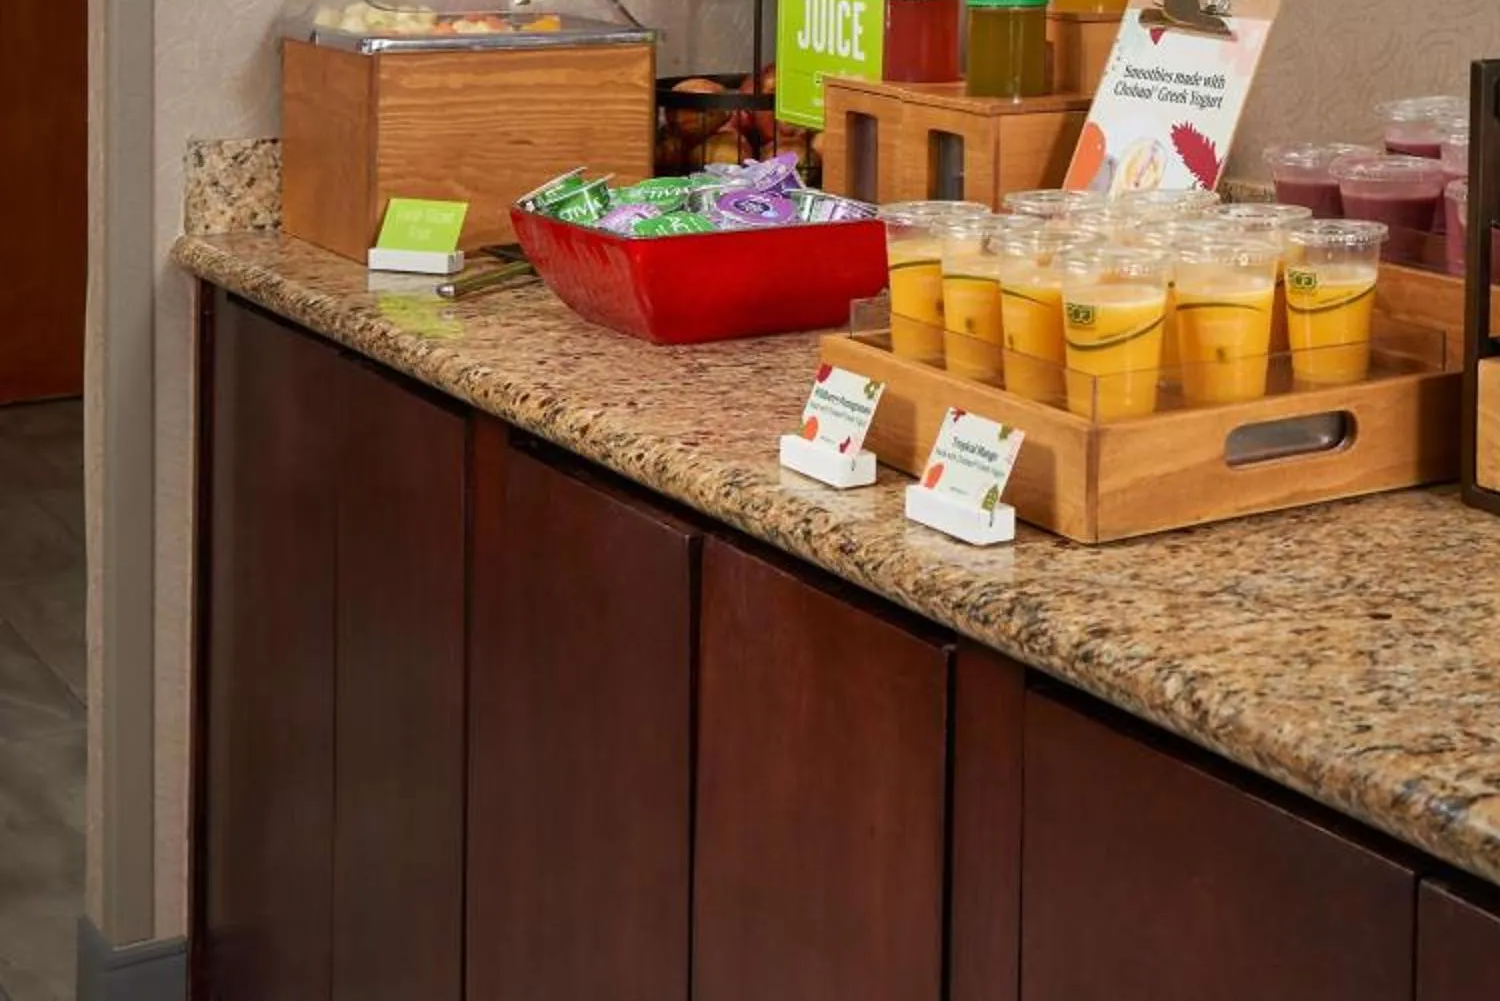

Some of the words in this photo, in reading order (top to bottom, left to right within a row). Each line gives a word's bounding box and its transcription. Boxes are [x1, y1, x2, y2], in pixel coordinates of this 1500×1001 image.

[1123, 64, 1174, 84] Smoothies
[1174, 71, 1202, 86] made
[1203, 74, 1226, 89] with
[1157, 87, 1188, 104] Greek
[1189, 90, 1223, 109] Yogurt
